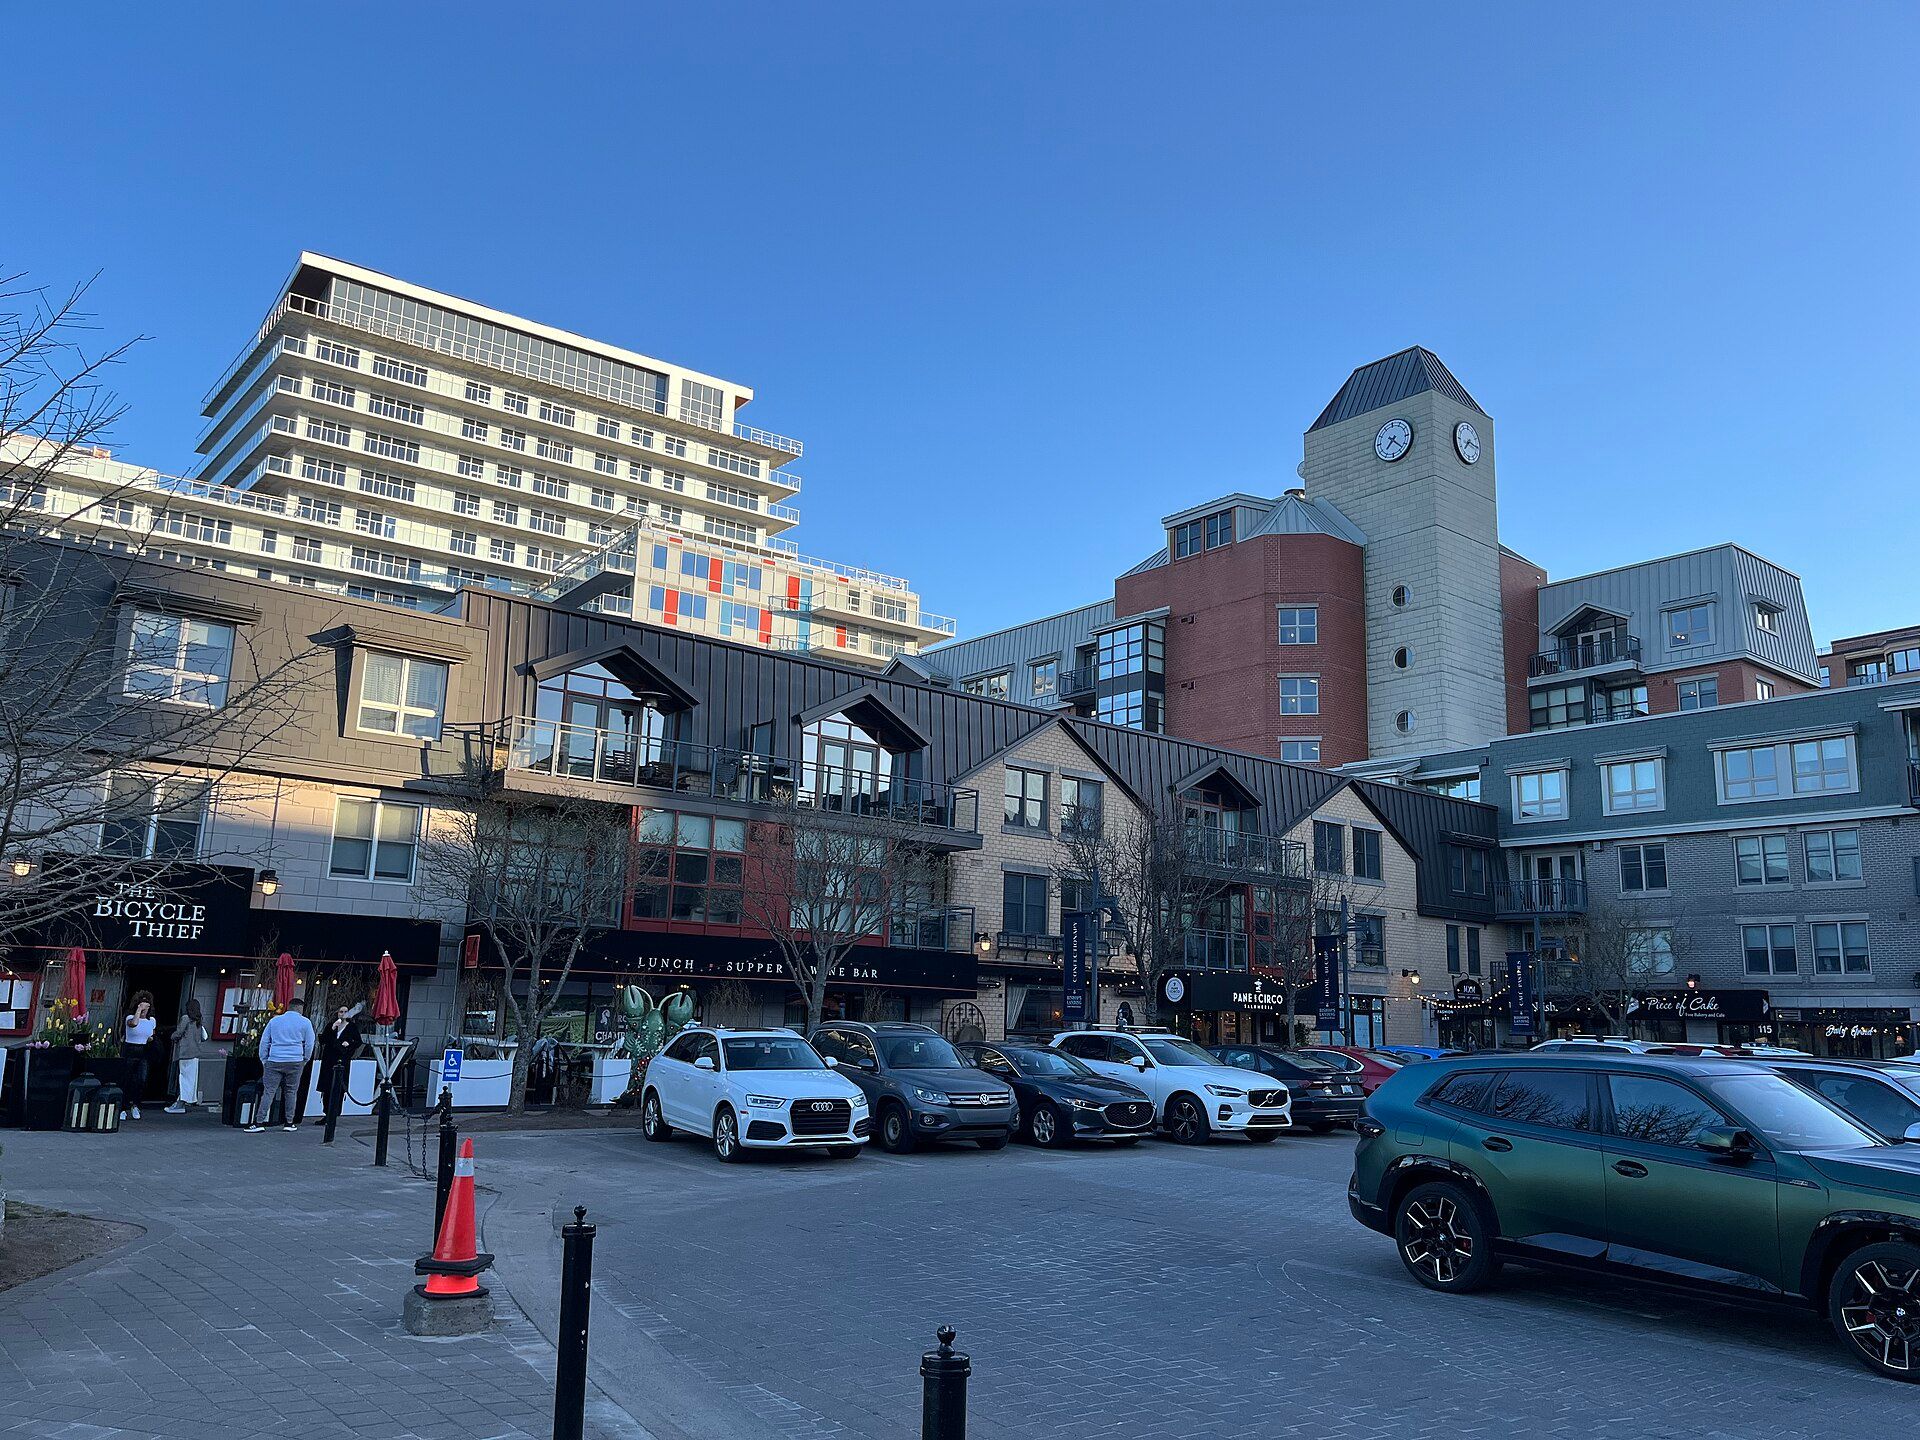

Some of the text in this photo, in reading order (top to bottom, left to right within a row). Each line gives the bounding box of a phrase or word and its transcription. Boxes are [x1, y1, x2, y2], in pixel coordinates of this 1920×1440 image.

[114, 882, 156, 899] THE
[93, 896, 206, 922] BICYCLE
[129, 920, 204, 940] THIEF
[638, 957, 878, 979] LUNCH SUPPER WNE BAR
[1233, 992, 1253, 1003] PANE
[1258, 993, 1284, 1005] CIRCO
[1646, 995, 1720, 1017] Piece of Cake
[1483, 1019, 1493, 1027] 120
[1758, 1025, 1773, 1034] 115
